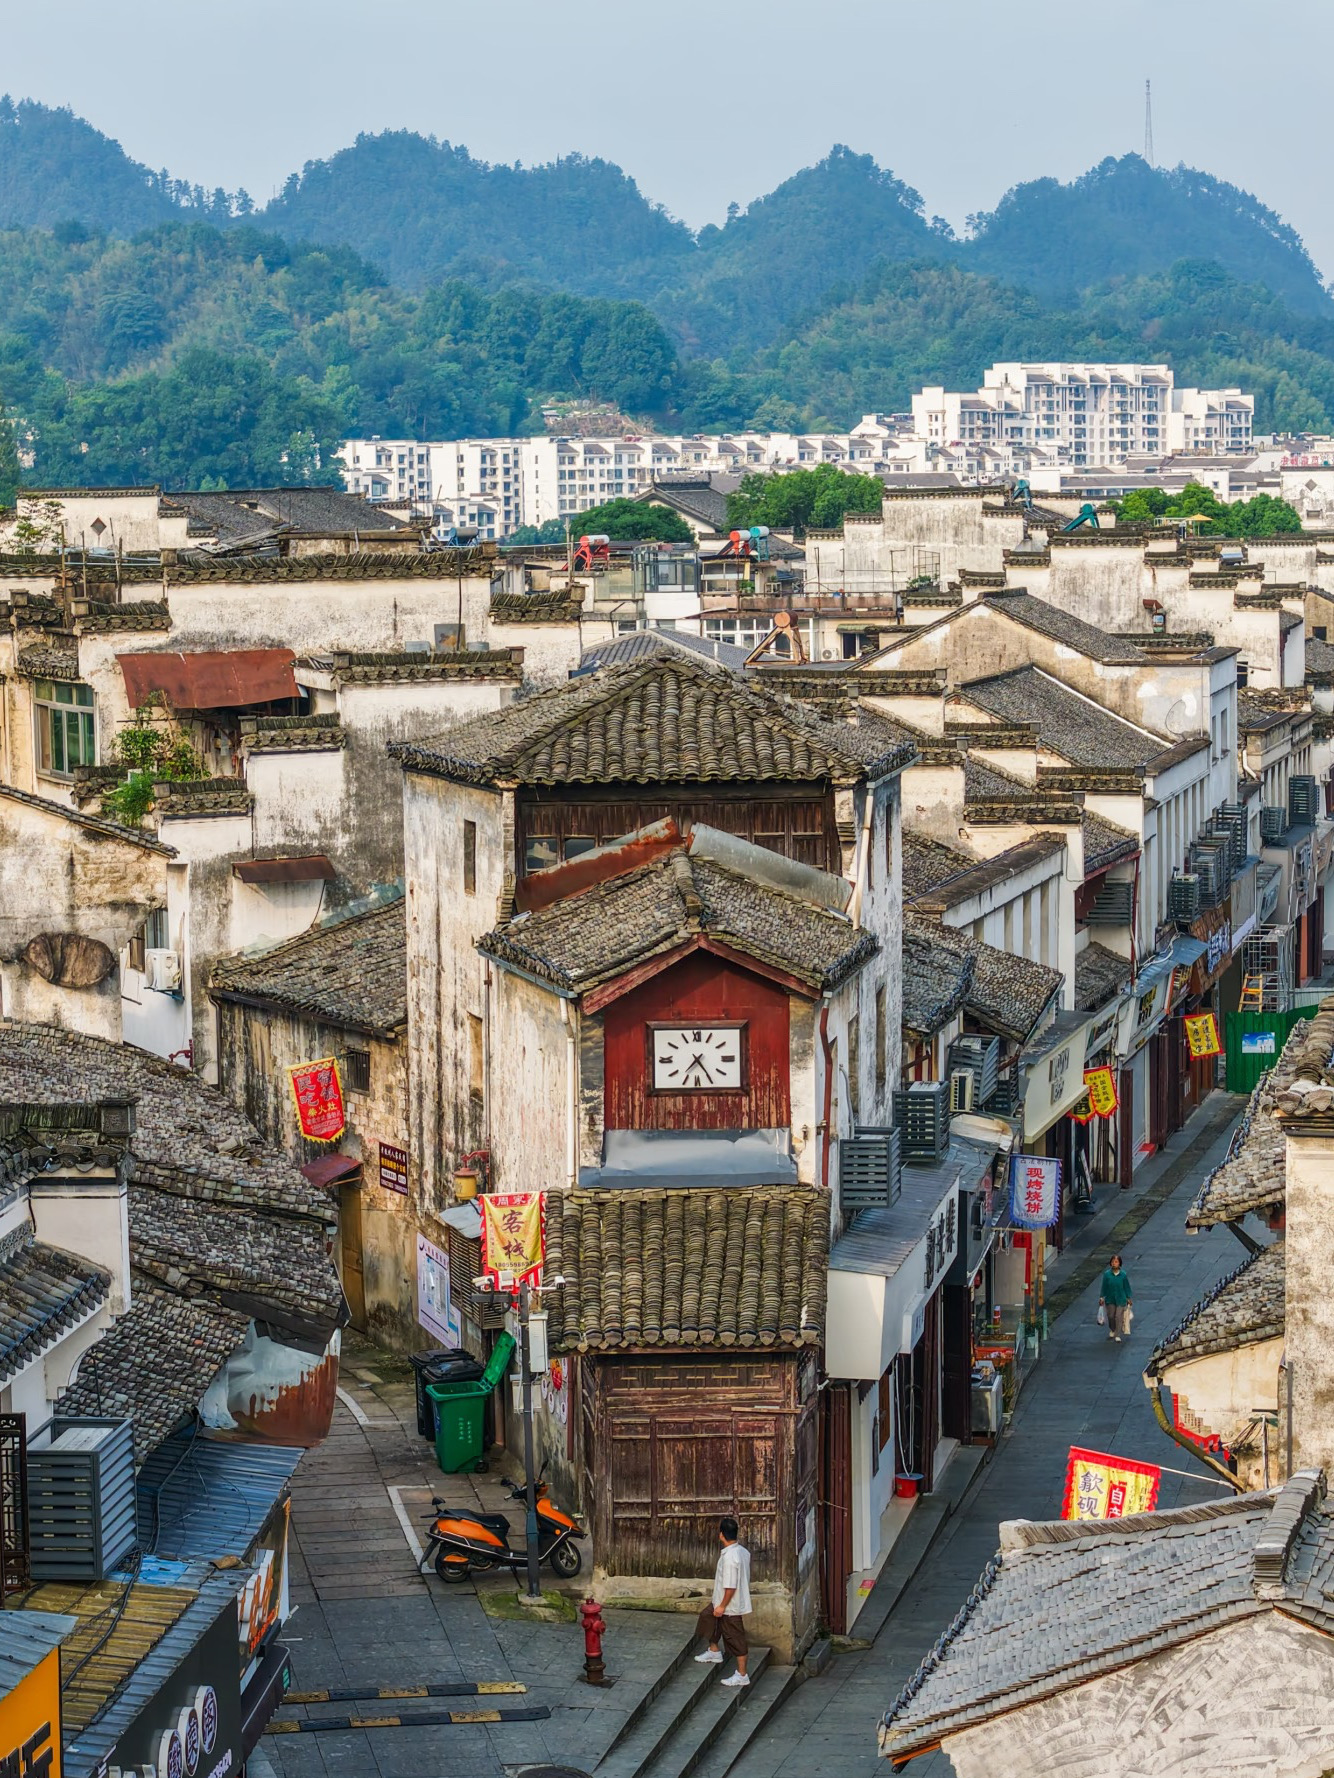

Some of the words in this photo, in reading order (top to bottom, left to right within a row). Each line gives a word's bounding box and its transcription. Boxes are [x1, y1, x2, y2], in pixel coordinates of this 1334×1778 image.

[497, 1195, 526, 1206] 周家
[1024, 1167, 1045, 1214] 现烤烧饼
[501, 1209, 529, 1260] 客栈
[1077, 1470, 1104, 1520] 歙砚
